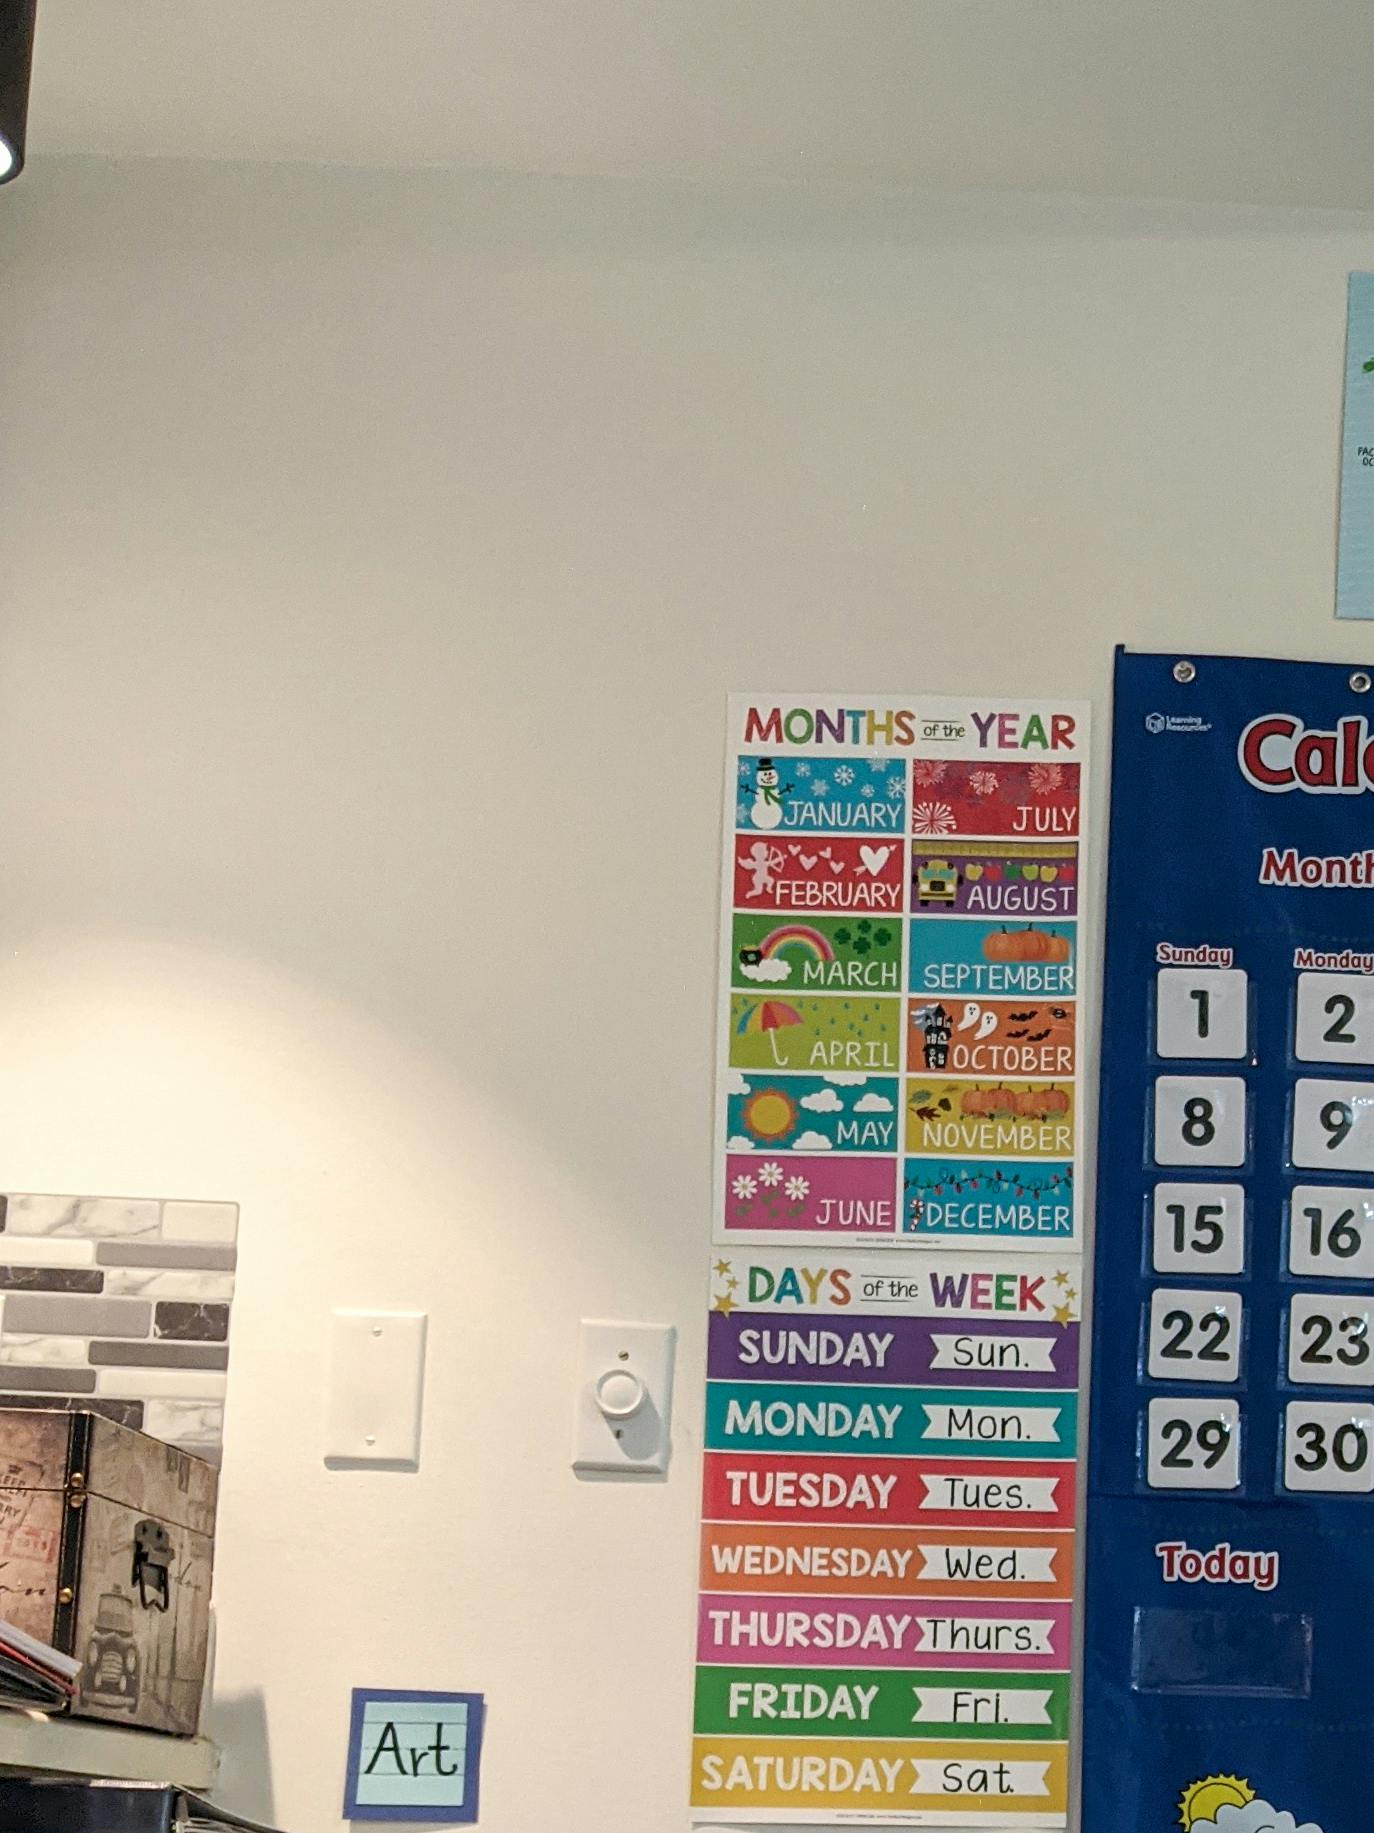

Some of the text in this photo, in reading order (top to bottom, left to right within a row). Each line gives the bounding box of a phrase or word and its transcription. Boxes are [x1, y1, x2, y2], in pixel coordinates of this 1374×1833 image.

[743, 706, 1077, 750] MONTHS of the YEAR
[784, 801, 901, 827] JANUARY
[1012, 805, 1077, 832] JULY
[775, 880, 900, 907] FEBRUARY
[967, 885, 1075, 911] AUGUST
[802, 961, 898, 987] MARCH
[1156, 943, 1233, 967] Sunday
[923, 964, 1075, 991] SEPTEMBER
[1190, 988, 1210, 1039] 1
[1322, 994, 1357, 1044] 2
[810, 1040, 895, 1067] APRIL
[953, 1045, 1073, 1072] OCTOBER
[836, 1120, 894, 1145] MAY
[922, 1125, 1072, 1151] NOVEMBER
[1182, 1097, 1215, 1146] 8
[1320, 1101, 1352, 1149] 9
[815, 1199, 892, 1227] JUNE
[925, 1203, 1070, 1232] DECEMBER
[1166, 1204, 1223, 1253] 15
[1303, 1208, 1361, 1258] 16
[748, 1266, 1046, 1312] DAYS of the WEEK
[738, 1329, 1029, 1368] SUNDAY Sun.
[1160, 1310, 1230, 1361] 22
[1300, 1315, 1369, 1366] 23
[724, 1399, 1031, 1440] MONDAY Mon.
[1161, 1419, 1230, 1469] 29
[1295, 1423, 1368, 1472] 30
[726, 1471, 1032, 1511] TUESDAY Tues.
[711, 1544, 1026, 1580] WEDNESDAY Wed.
[1155, 1541, 1279, 1590] Today
[708, 1610, 1042, 1652] THURSDAY Thurs.
[728, 1682, 1009, 1723] FRIDAY Fri.
[365, 1721, 458, 1777] Art
[701, 1756, 1015, 1793] SATURDAY Sat.
